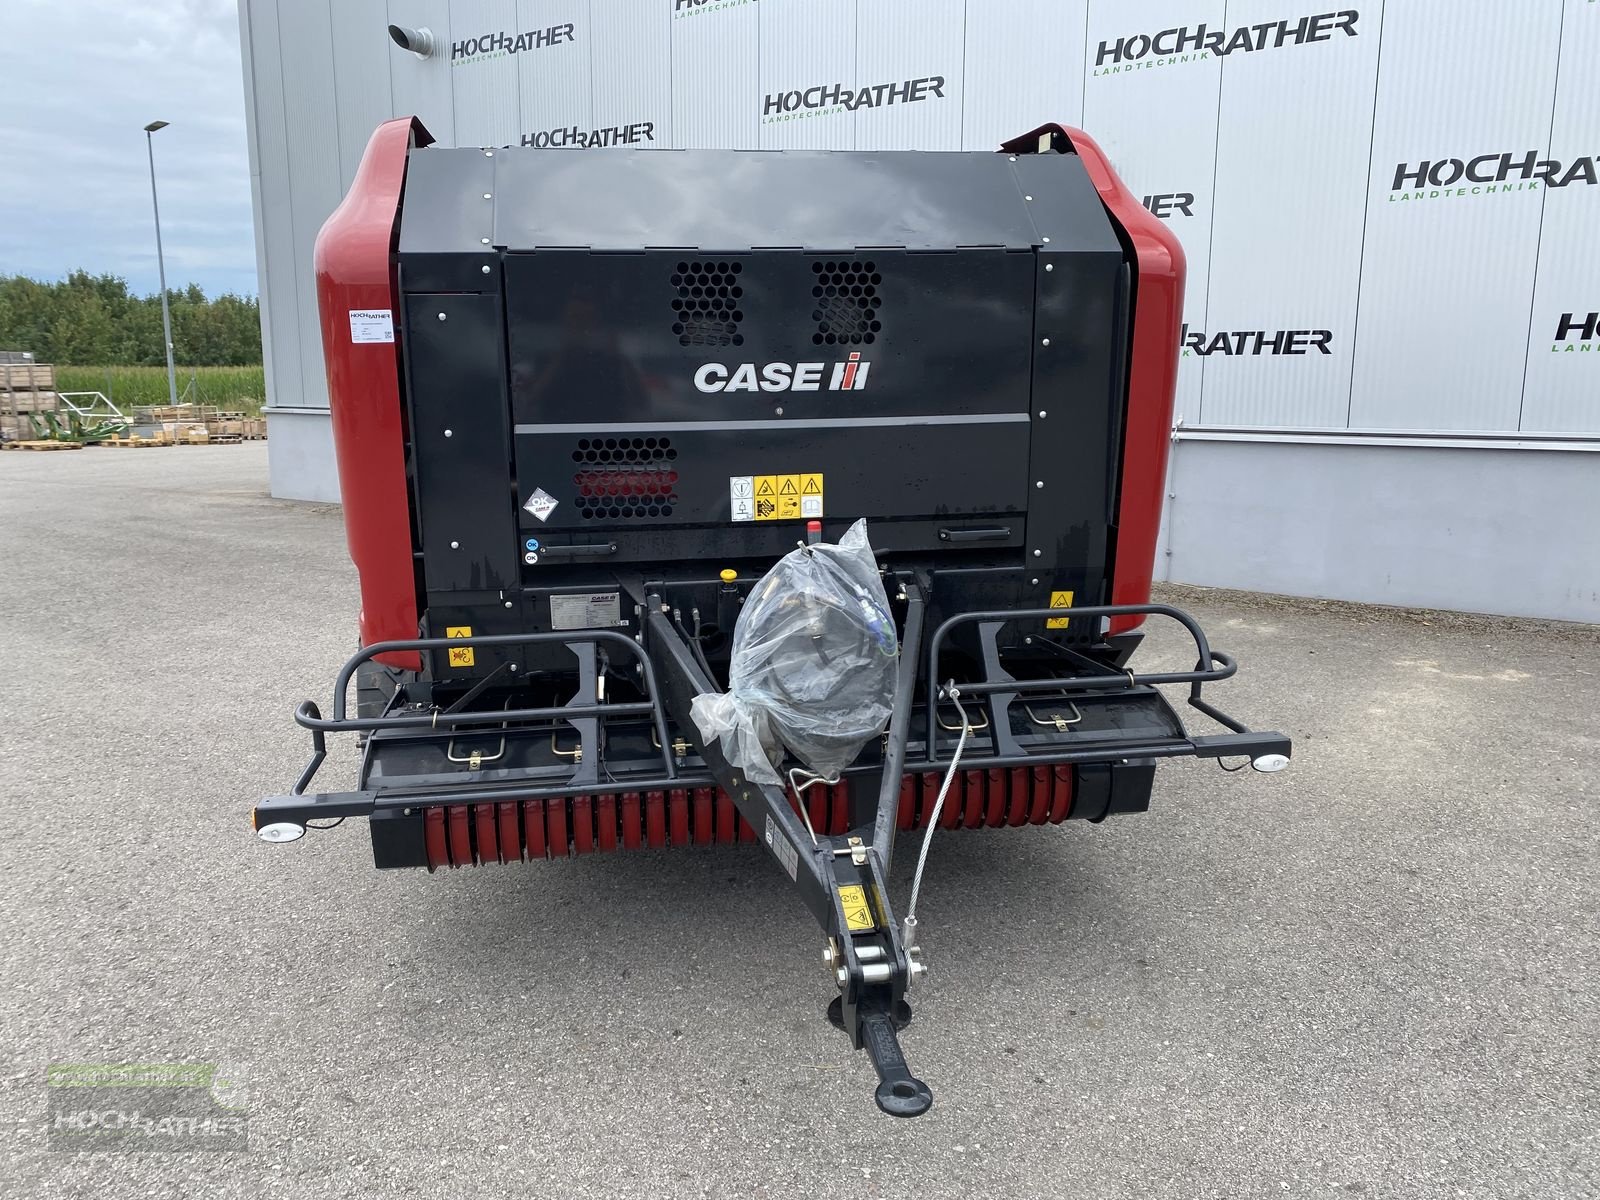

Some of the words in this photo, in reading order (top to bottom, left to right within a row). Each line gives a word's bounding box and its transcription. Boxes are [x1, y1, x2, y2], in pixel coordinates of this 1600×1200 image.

[451, 22, 575, 60] HOCHRATHER
[1095, 9, 1360, 66] HOCHRATHER
[1093, 52, 1209, 77] LANDTECHNIK
[763, 75, 945, 116] HOCHRATHER
[762, 106, 843, 124] LANDTECHNIK
[521, 121, 654, 148] HOCHRATHER
[1391, 150, 1600, 190] HOCHRA
[1388, 181, 1539, 202] LANDTECHNIK
[693, 361, 825, 394] CASE
[531, 496, 549, 507] OK
